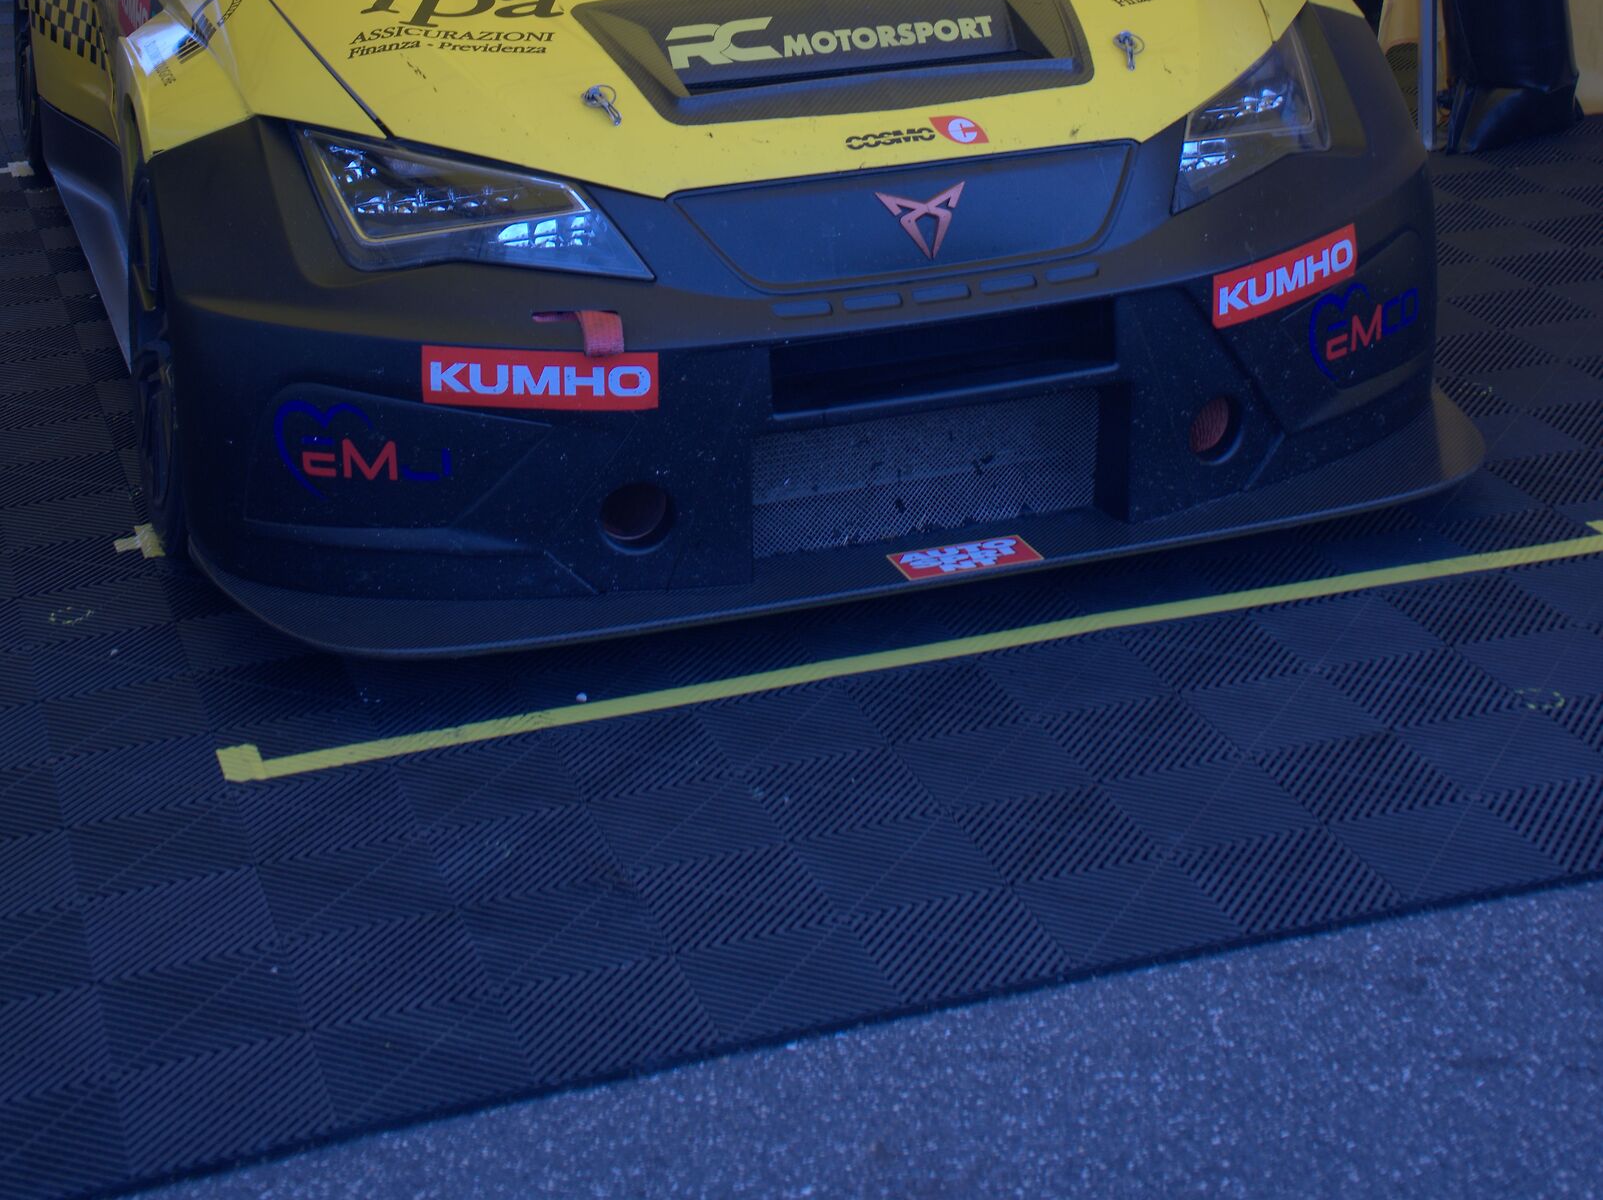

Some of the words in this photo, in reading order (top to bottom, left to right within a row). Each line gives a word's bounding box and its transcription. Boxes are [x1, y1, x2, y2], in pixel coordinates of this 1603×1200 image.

[347, 40, 421, 59] Finanza
[439, 42, 547, 54] Previdenza
[349, 25, 555, 45] ASSICURAZIONI
[783, 15, 993, 59] MOTORSPORT
[845, 126, 936, 150] COSMO
[1218, 239, 1354, 316] KUMHO
[429, 361, 651, 397] KUMHO
